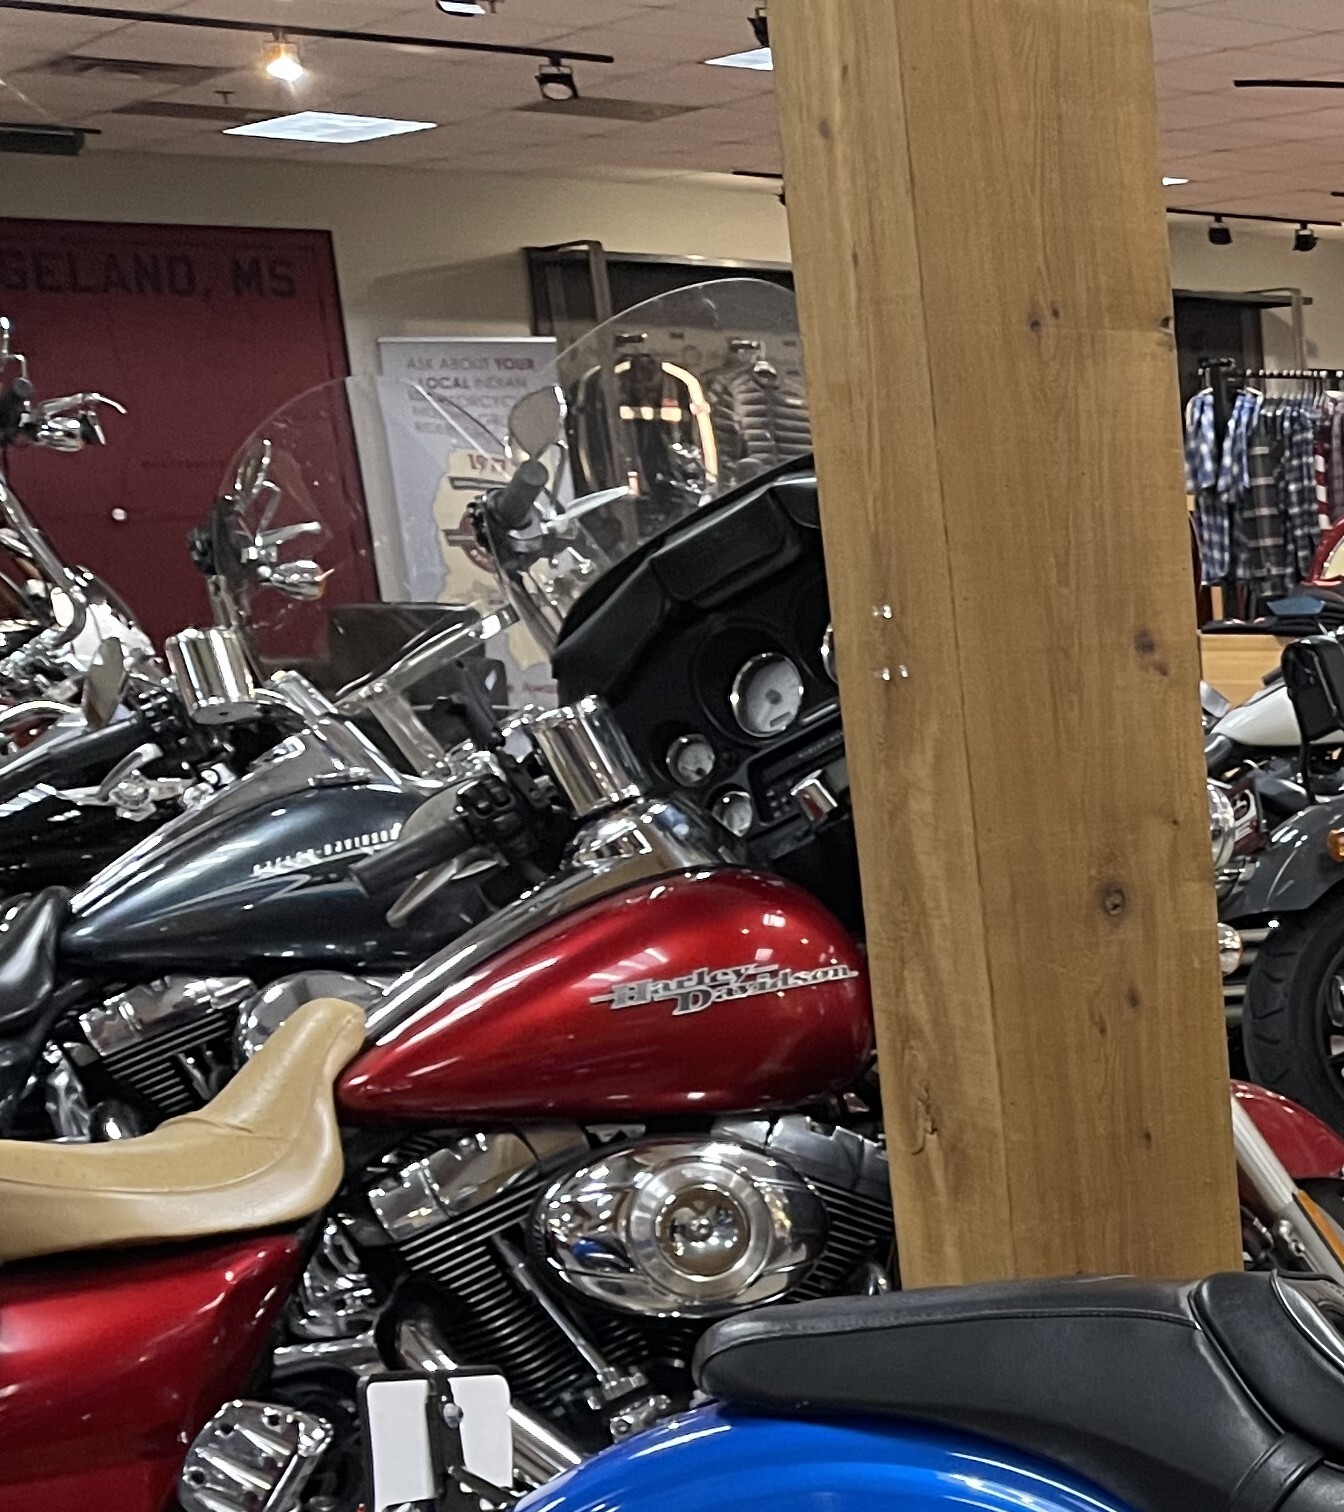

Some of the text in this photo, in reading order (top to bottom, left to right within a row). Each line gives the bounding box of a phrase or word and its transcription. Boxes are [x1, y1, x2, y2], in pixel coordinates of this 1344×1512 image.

[230, 254, 297, 299] MS
[418, 376, 470, 390] LOCAL
[493, 357, 535, 371] YOUR
[604, 963, 778, 1010] Harley
[671, 964, 859, 1017] Davidson
